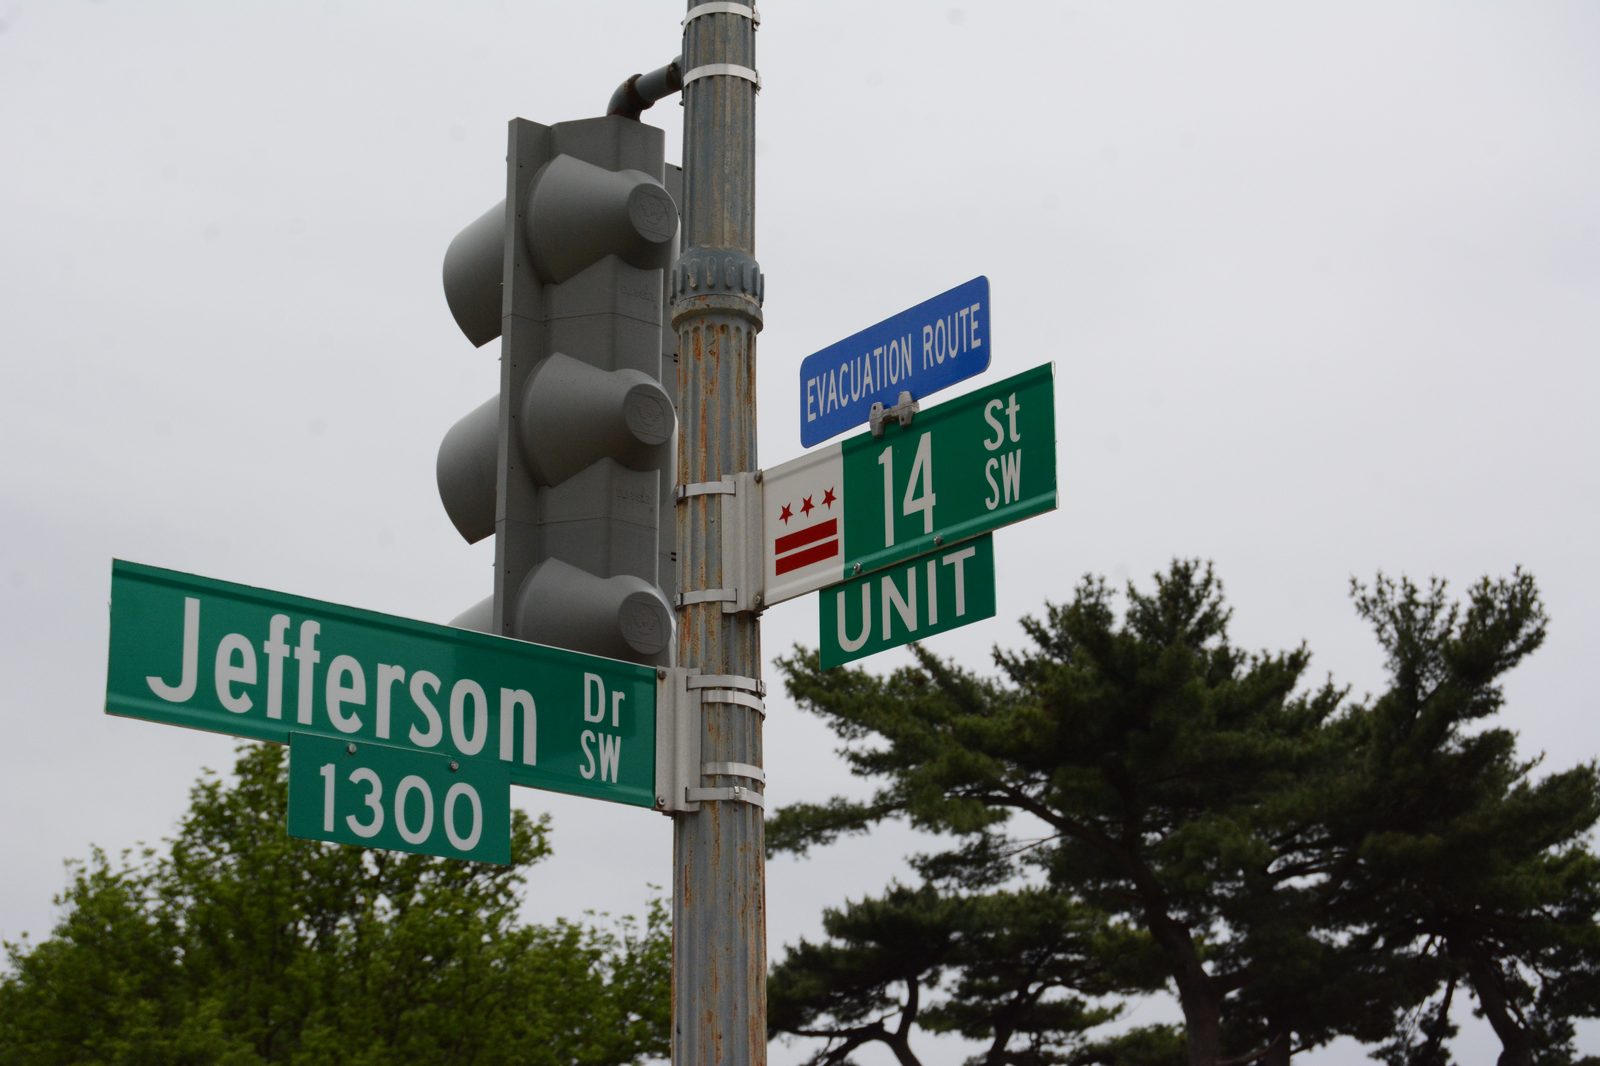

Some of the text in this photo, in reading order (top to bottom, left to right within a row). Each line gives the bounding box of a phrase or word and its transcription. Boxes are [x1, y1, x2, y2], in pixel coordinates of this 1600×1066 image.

[806, 303, 981, 423] EVACUATION ROUTE
[983, 392, 1021, 451] St
[878, 431, 936, 548] 14
[985, 448, 1022, 511] SW
[836, 546, 976, 653] UNIT
[145, 596, 538, 766] Jefferson
[584, 672, 625, 727] Dr
[579, 729, 622, 784] SW
[319, 763, 483, 852] 1300
